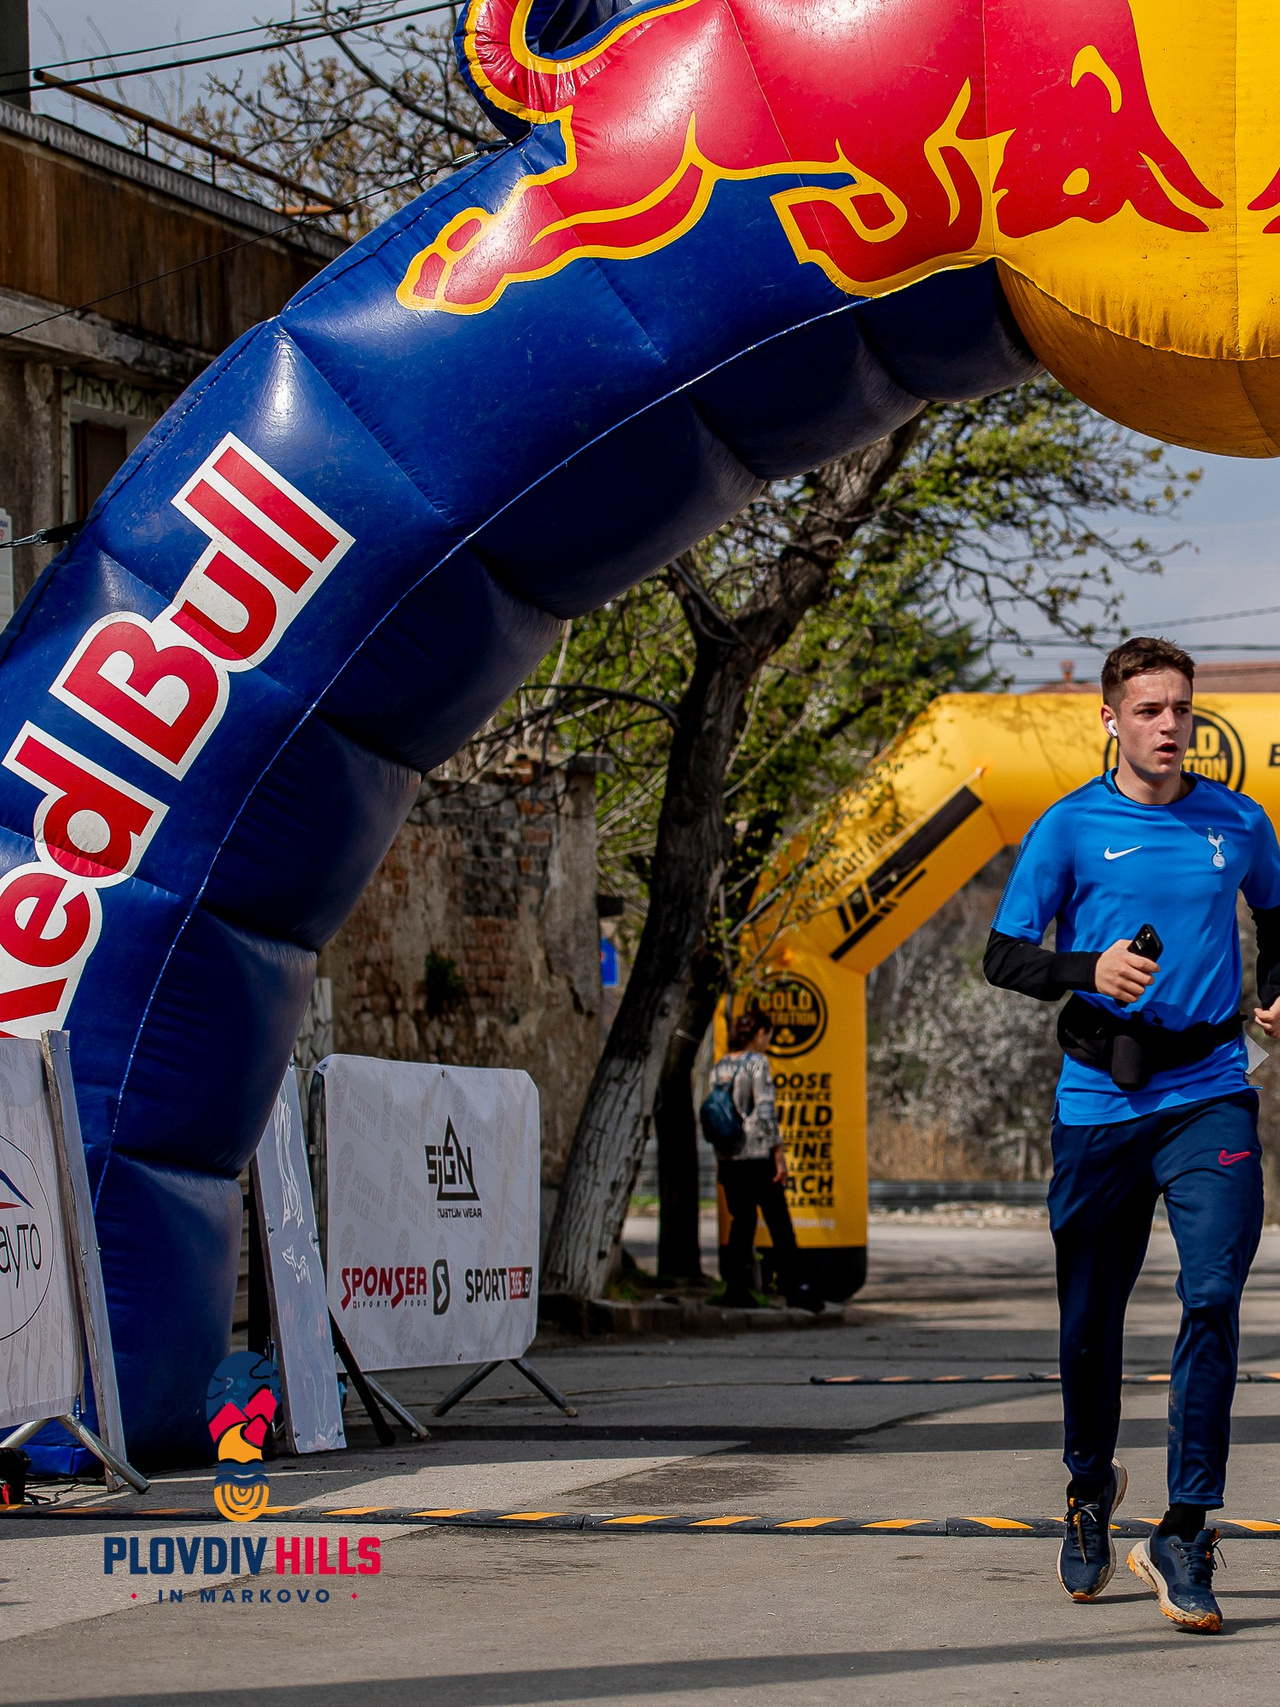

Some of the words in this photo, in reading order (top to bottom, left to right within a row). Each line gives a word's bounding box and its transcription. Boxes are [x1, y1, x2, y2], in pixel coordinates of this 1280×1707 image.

[54, 438, 349, 774] Bull
[773, 1073, 832, 1089] OOSE
[784, 1175, 834, 1194] ACH
[463, 1208, 482, 1219] WEAR
[341, 1266, 427, 1311] SPONSER
[404, 1300, 427, 1308] FOOD
